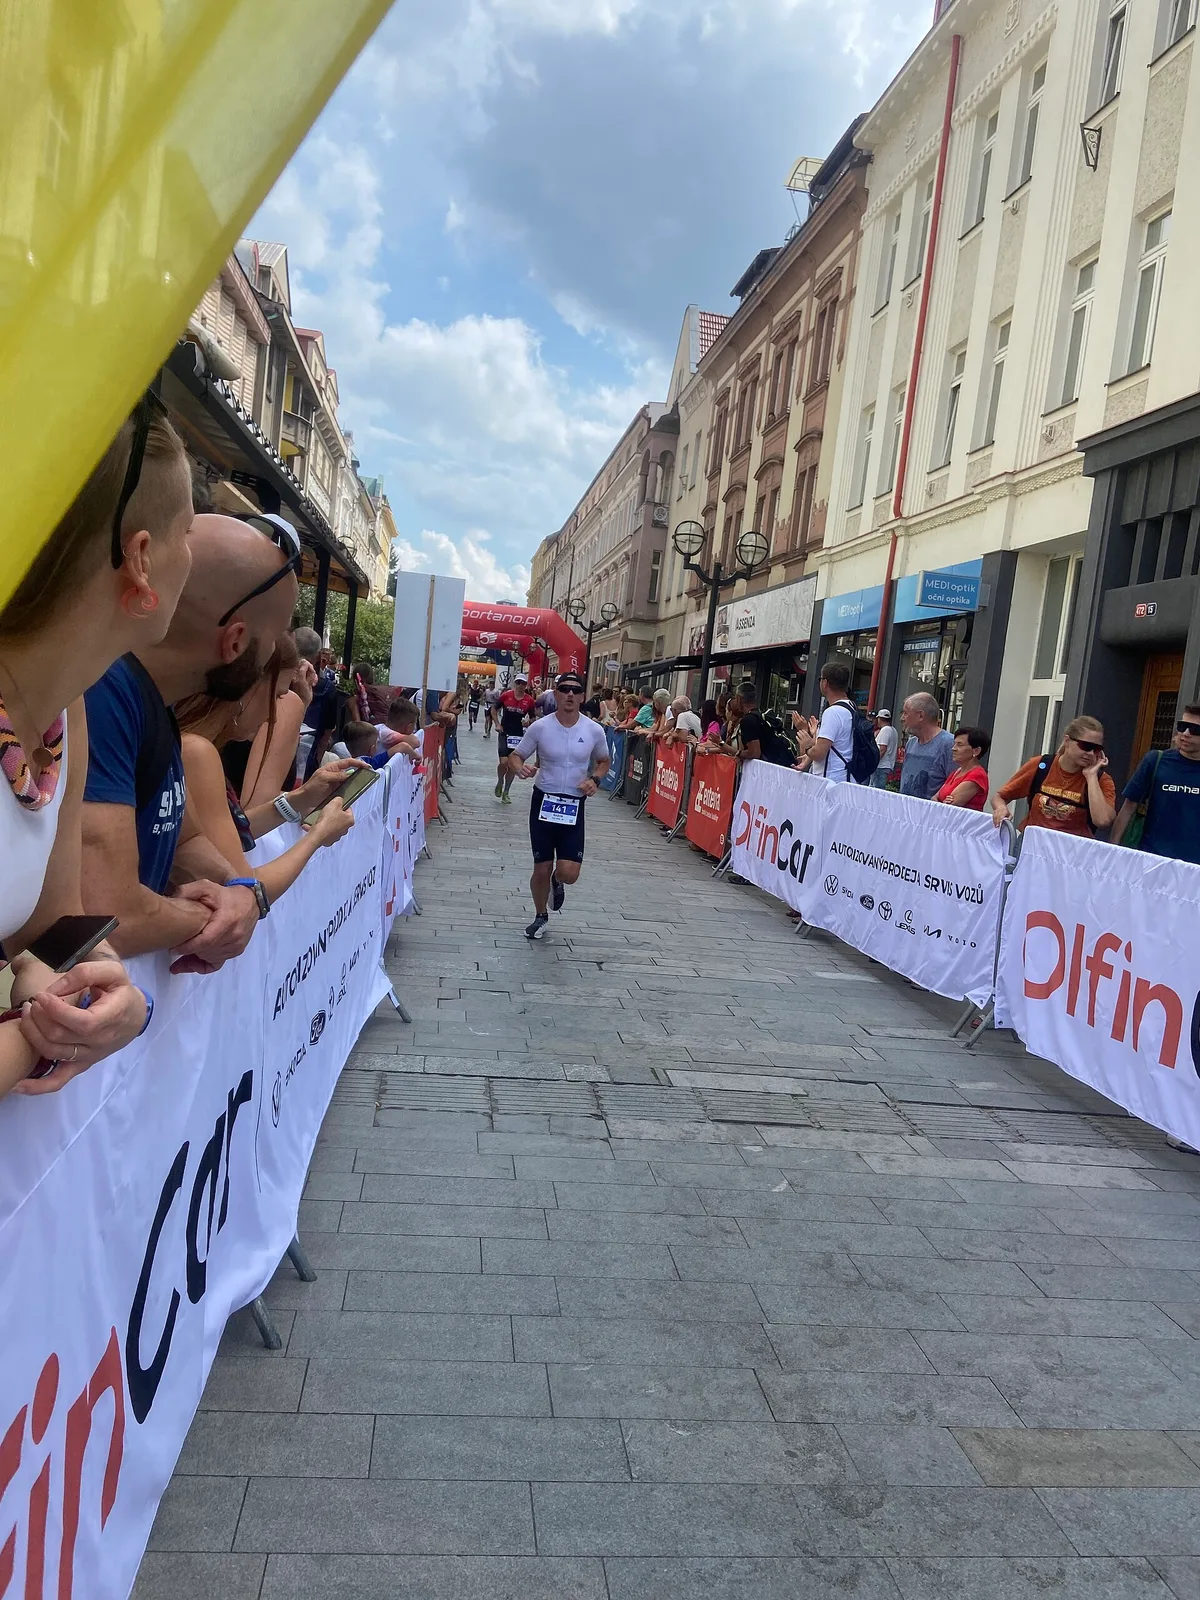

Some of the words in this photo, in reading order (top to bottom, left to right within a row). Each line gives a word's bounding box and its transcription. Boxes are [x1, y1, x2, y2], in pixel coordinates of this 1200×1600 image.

[927, 593, 945, 602] oční
[946, 596, 970, 605] optika
[462, 609, 541, 627] portano.pl
[551, 804, 567, 814] 141
[829, 841, 884, 872] AUTOIZOVANÝ
[923, 874, 953, 897] SRVIS
[955, 883, 984, 905] VOZŮ
